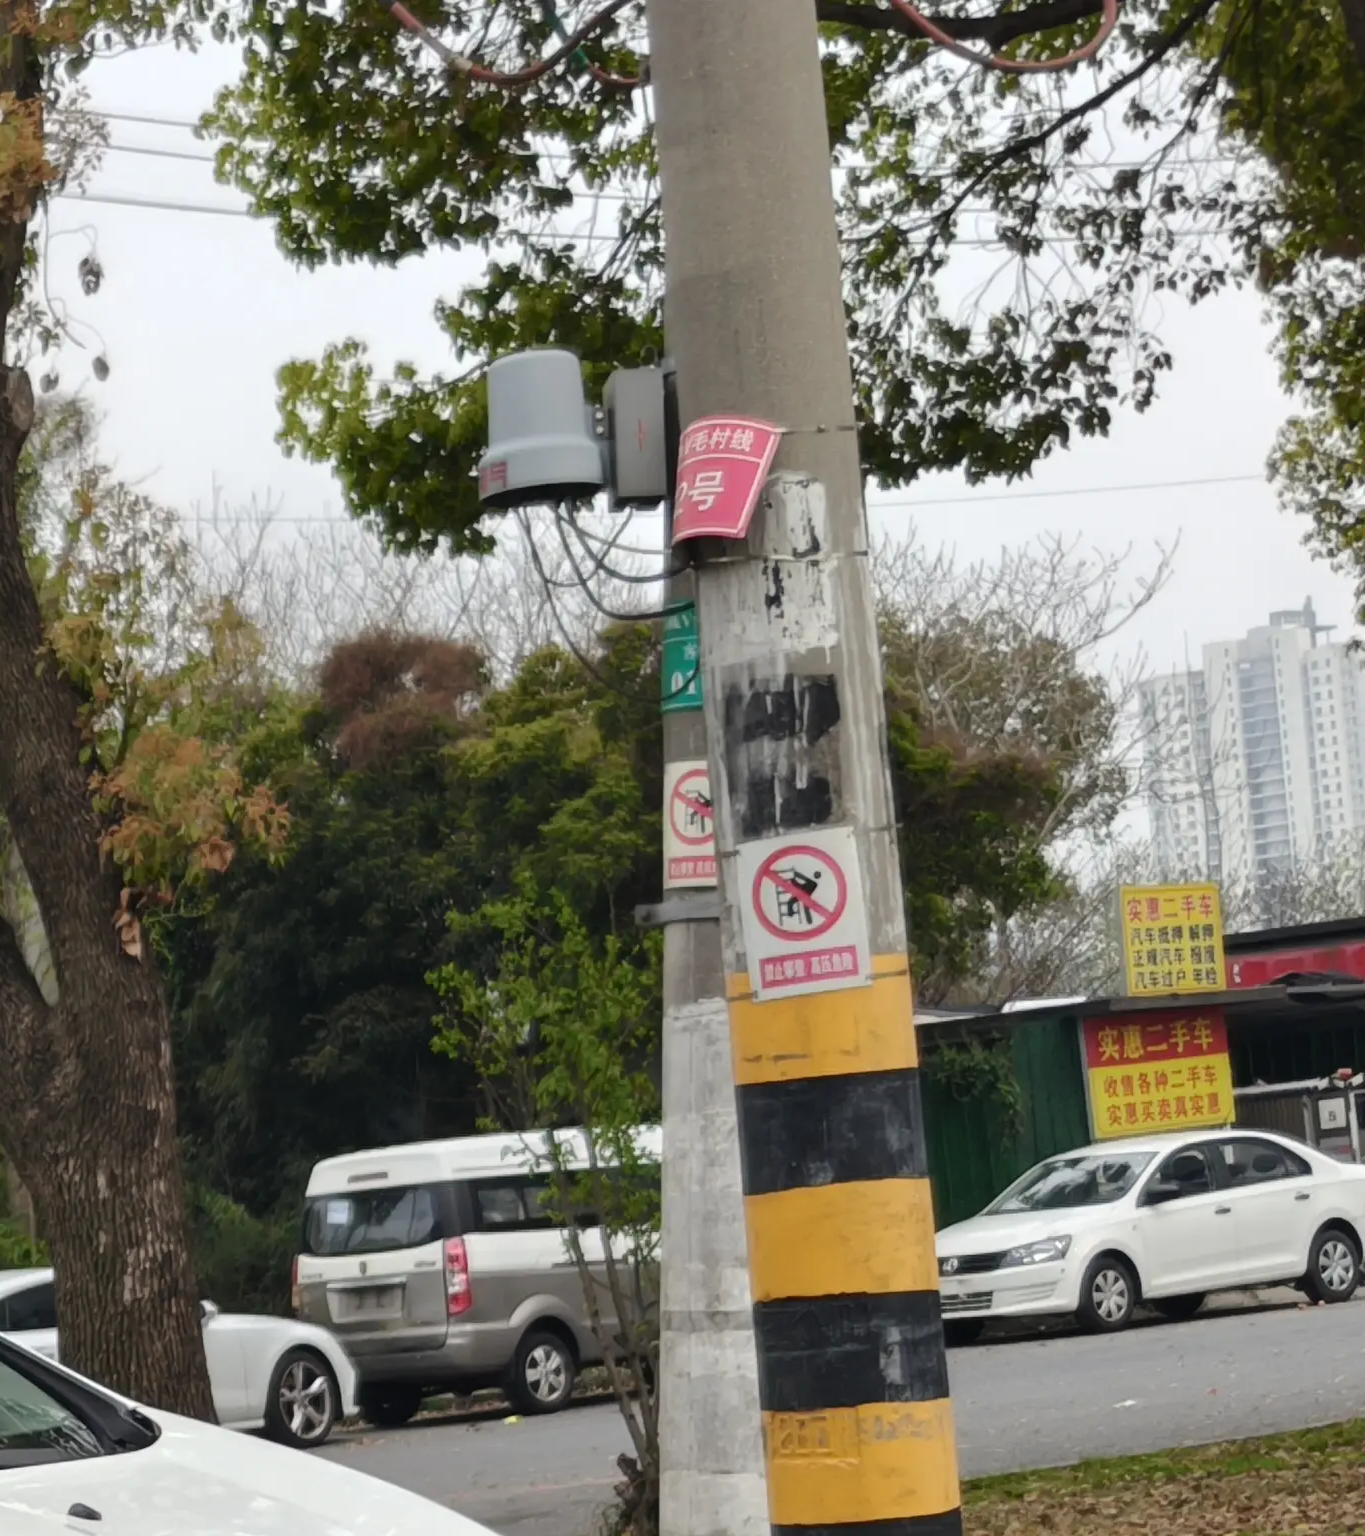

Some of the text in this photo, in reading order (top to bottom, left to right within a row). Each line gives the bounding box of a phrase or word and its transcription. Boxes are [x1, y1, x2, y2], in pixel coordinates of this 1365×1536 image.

[1127, 894, 1214, 924] 实惠二手车
[1097, 1017, 1214, 1062] 实惠二手车
[1103, 1064, 1218, 1098] 收售各种二手车
